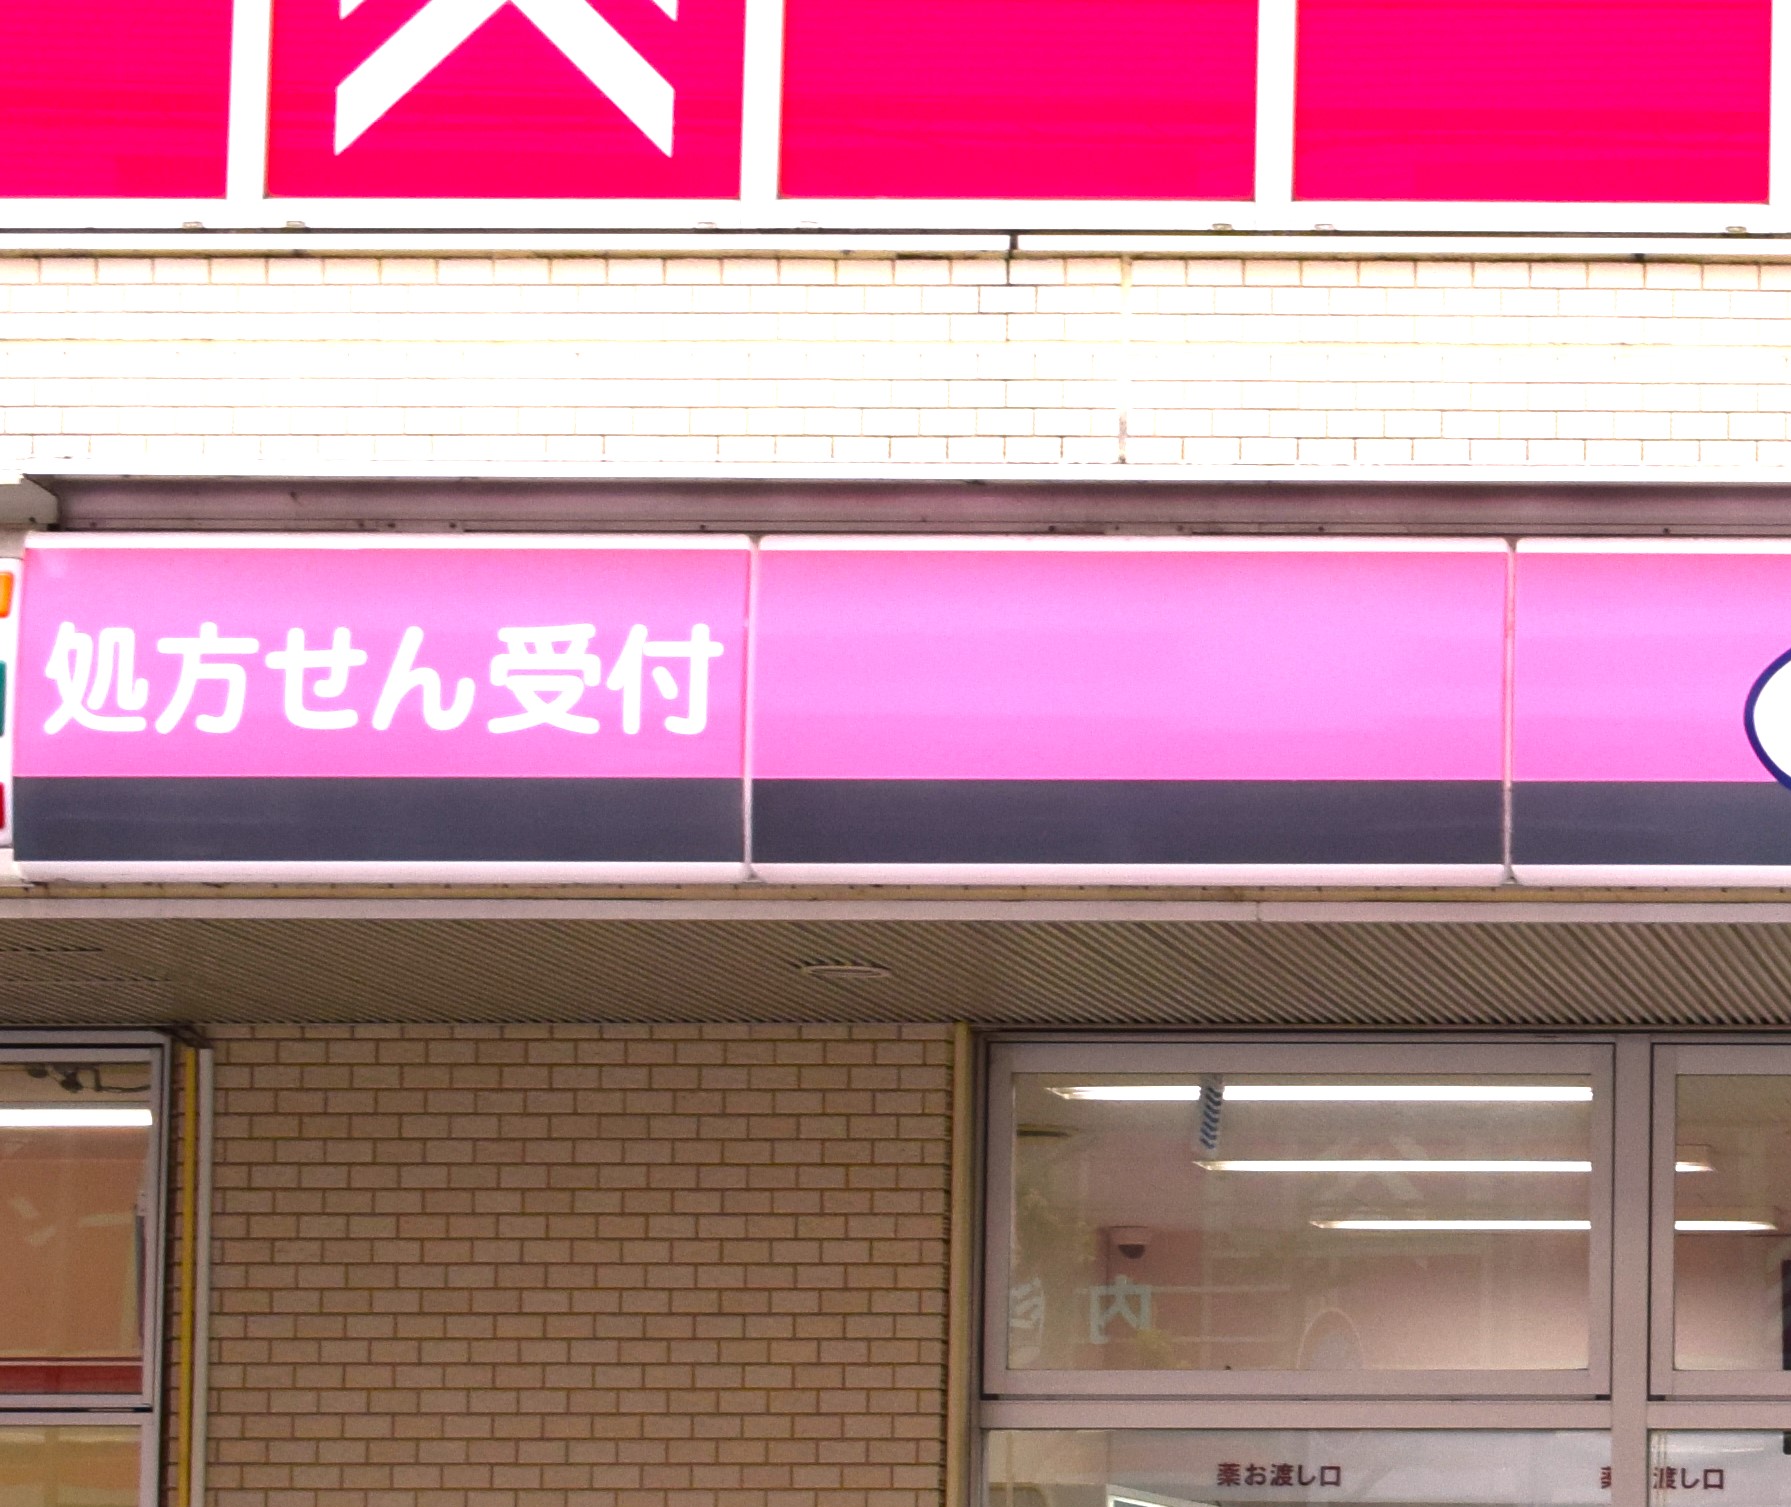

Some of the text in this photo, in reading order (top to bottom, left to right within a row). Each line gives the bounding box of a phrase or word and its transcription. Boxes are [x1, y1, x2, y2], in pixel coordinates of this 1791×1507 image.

[44, 621, 724, 736] 処方せん受付
[1217, 1461, 1342, 1488] 薬お渡し口
